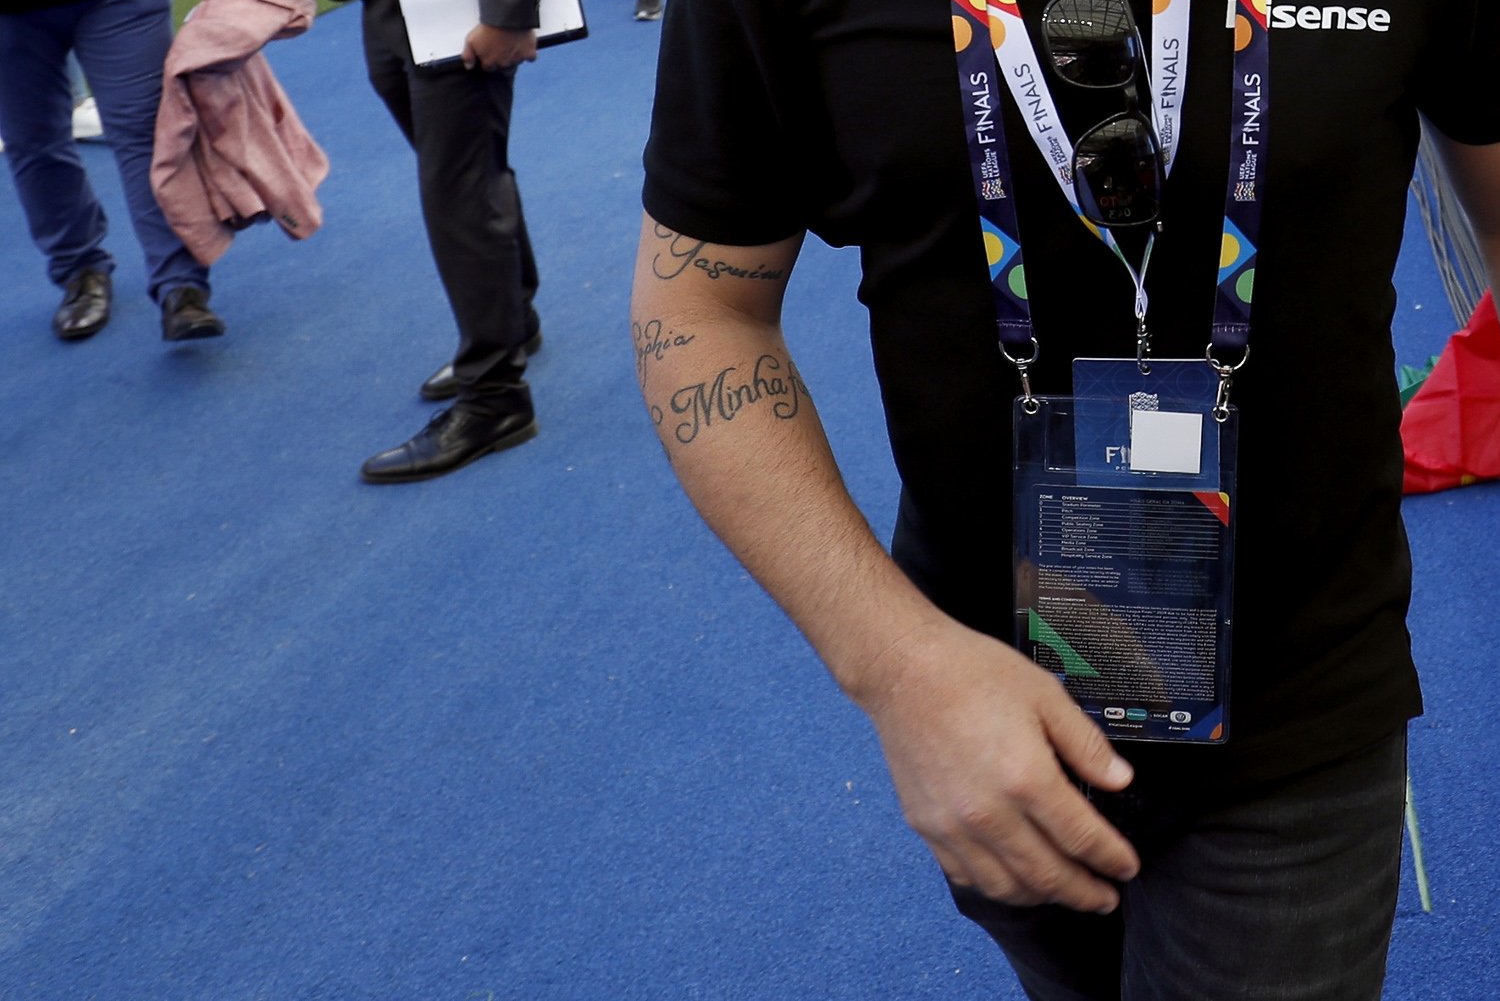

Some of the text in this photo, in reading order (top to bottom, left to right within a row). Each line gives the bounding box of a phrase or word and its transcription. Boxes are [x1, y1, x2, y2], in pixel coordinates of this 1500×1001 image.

[970, 71, 996, 145] FINALS
[1014, 63, 1053, 133] FINALS
[1161, 38, 1180, 109] FINALS
[1242, 73, 1262, 145] FINALS
[670, 354, 788, 444] Minha
